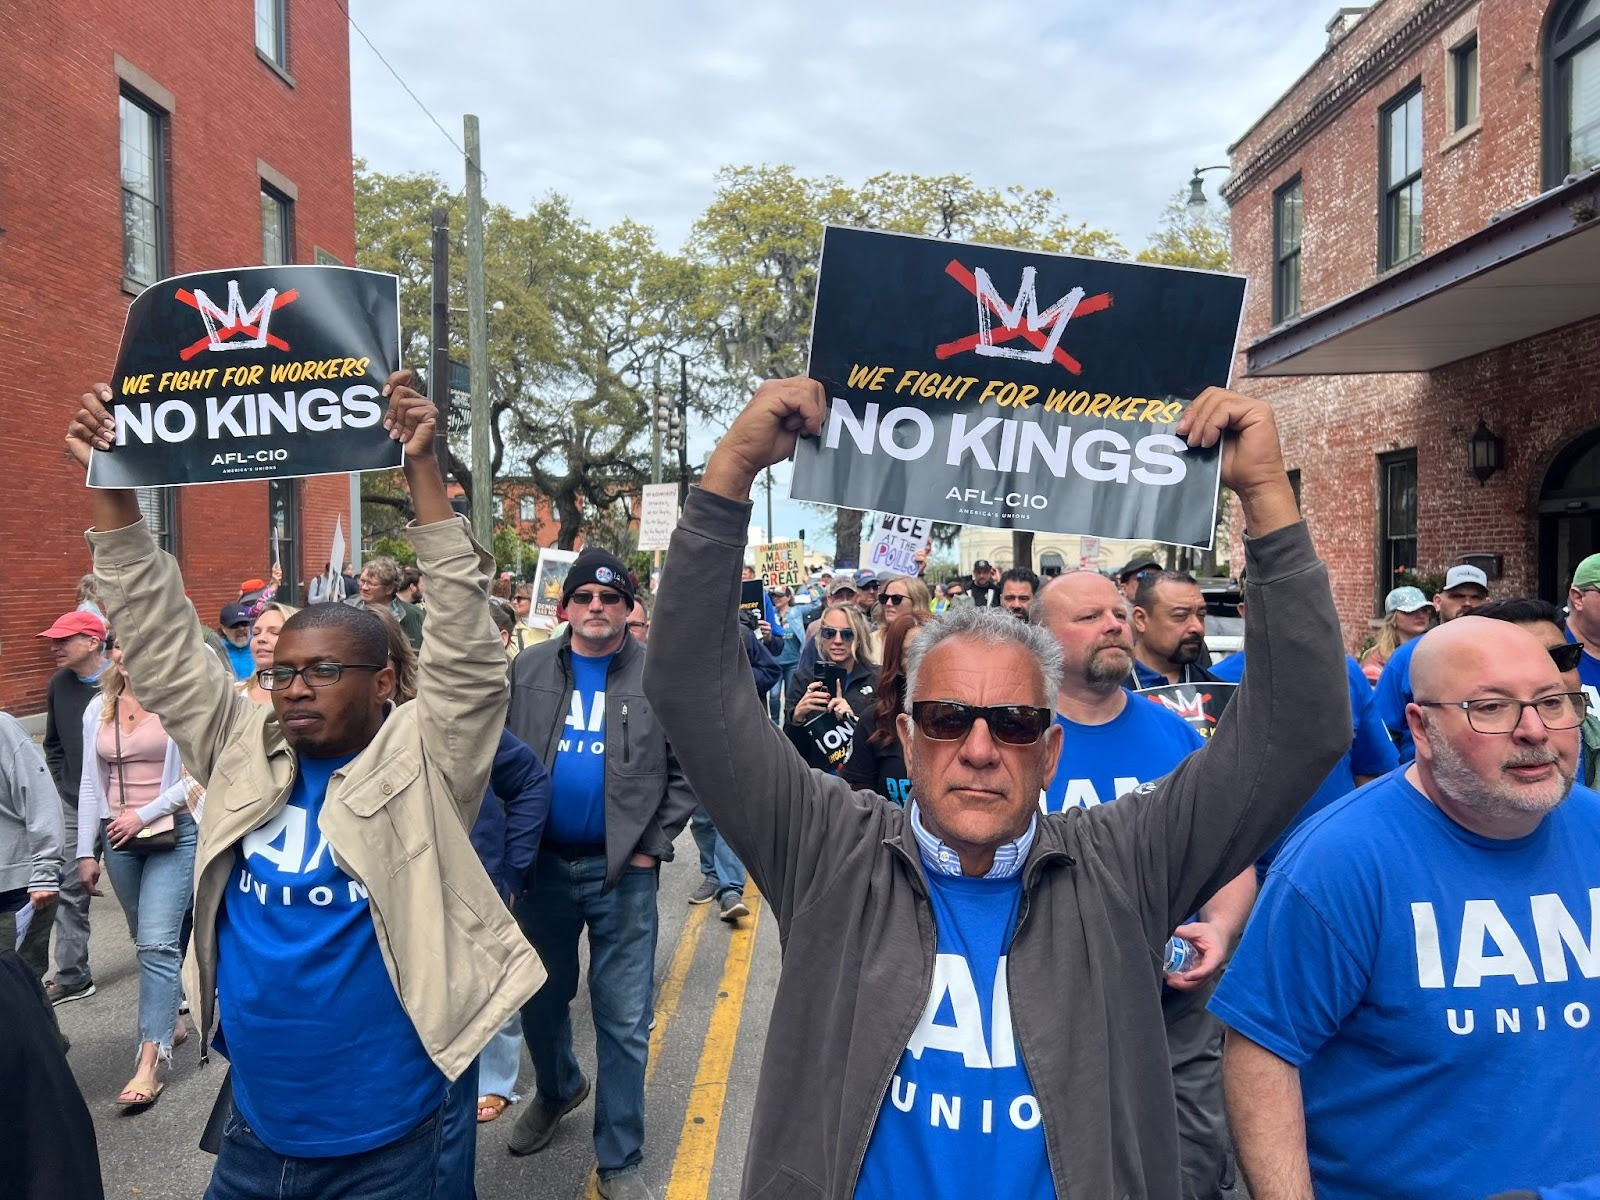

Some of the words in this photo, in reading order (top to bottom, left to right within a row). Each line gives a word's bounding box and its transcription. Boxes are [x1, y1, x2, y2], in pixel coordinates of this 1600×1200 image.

[122, 374, 154, 396] WE
[158, 368, 218, 392] FIGHT
[221, 364, 265, 387] FOR
[270, 356, 371, 384] WORKERS
[847, 363, 894, 391] WE
[895, 370, 979, 402] FIGHT
[979, 380, 1040, 410] FOR
[1043, 388, 1184, 425] WORKERS
[113, 399, 197, 446] NO
[205, 384, 382, 440] KINGS
[825, 397, 935, 461] NO
[945, 412, 1189, 487] KINGS
[210, 448, 288, 466] AFL-CIO
[945, 486, 1048, 510] AFL-CIO
[958, 508, 999, 518] AMERICA'S
[760, 542, 798, 553] IMMIGRANTS
[881, 533, 897, 546] AT
[900, 538, 917, 552] THE
[762, 560, 799, 573] AMERICA
[873, 542, 920, 576] POLLS
[762, 571, 799, 587] GREAT
[557, 739, 605, 755] NIO
[1446, 1002, 1591, 1036] UNIO
[891, 1074, 1043, 1134] UNIO
